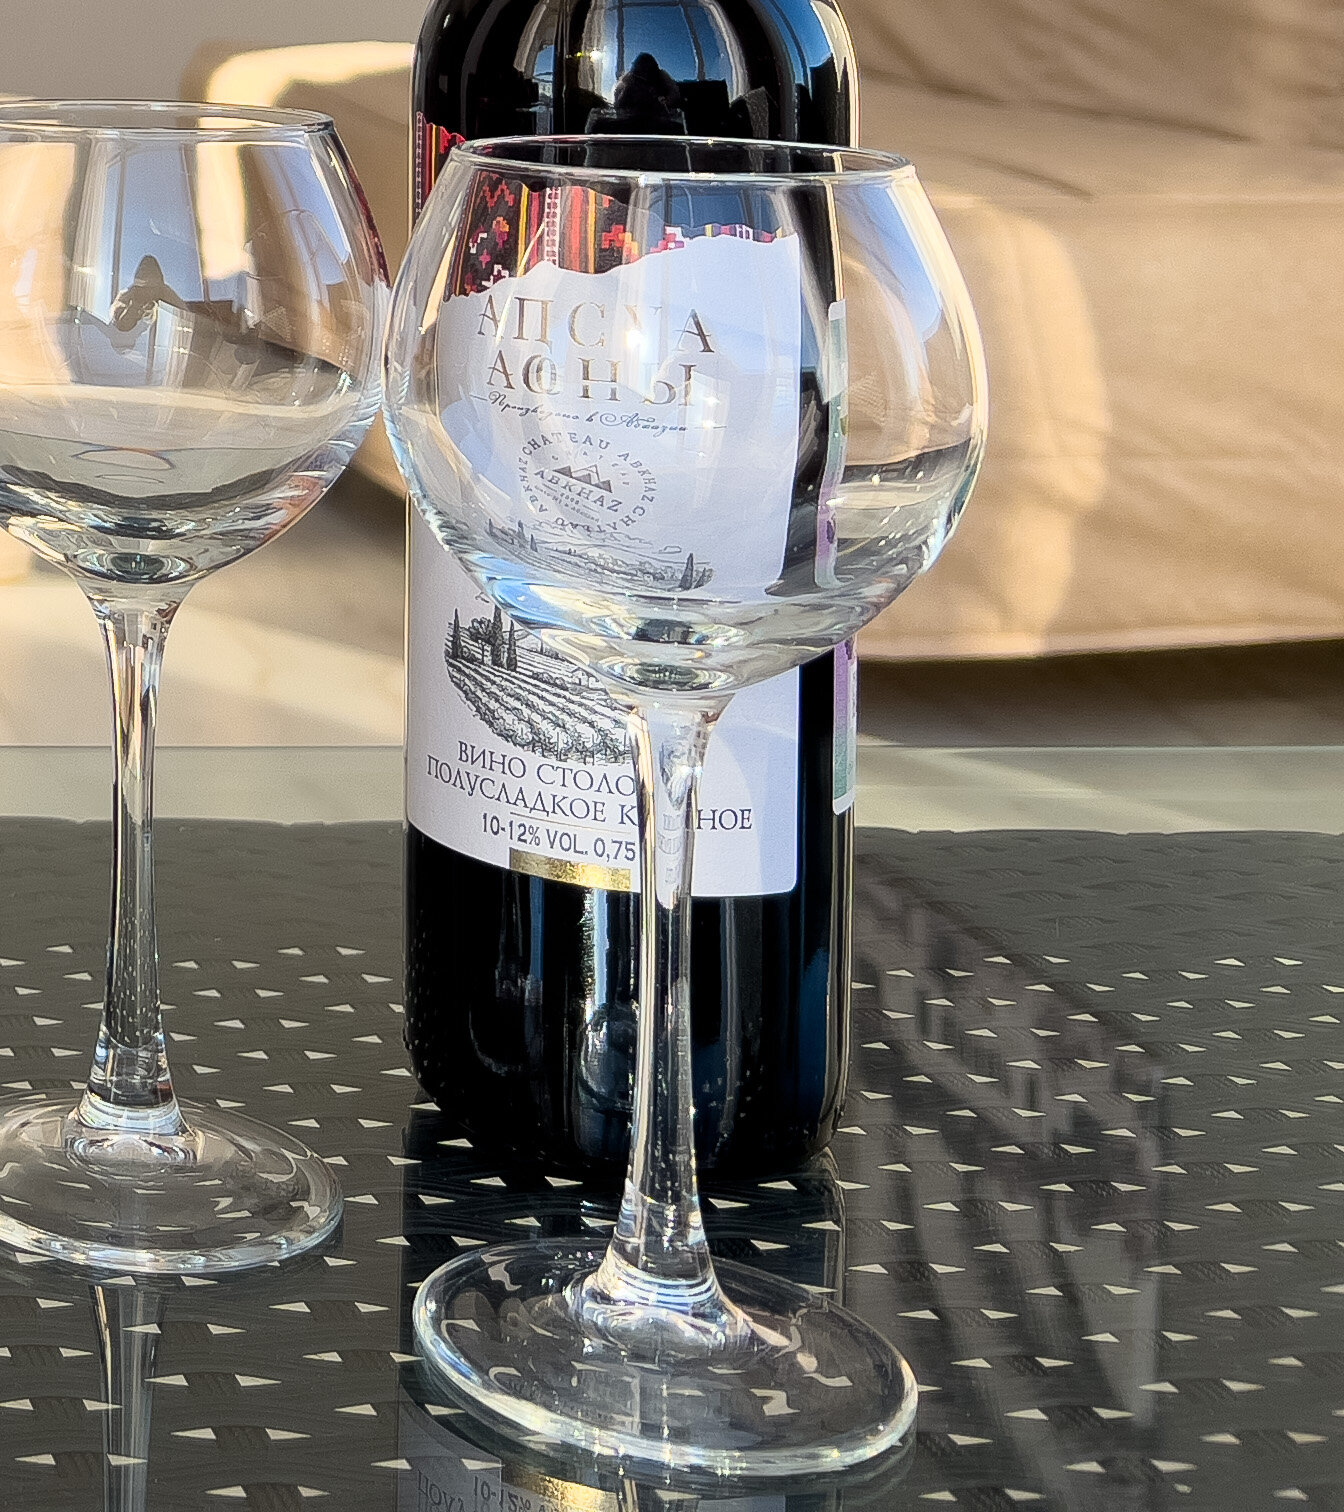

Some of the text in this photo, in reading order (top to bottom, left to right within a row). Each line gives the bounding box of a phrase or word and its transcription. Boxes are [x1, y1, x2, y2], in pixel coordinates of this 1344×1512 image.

[521, 431, 611, 456] CHATEAU
[617, 451, 658, 504] ABKHAZ
[534, 469, 624, 513] ABKHAZ
[426, 754, 607, 823] ПОЛУСЛАДКОЕ
[457, 740, 638, 796] ВИНО СТОЛО
[482, 812, 637, 862] 10-12% VOL. 0,75
